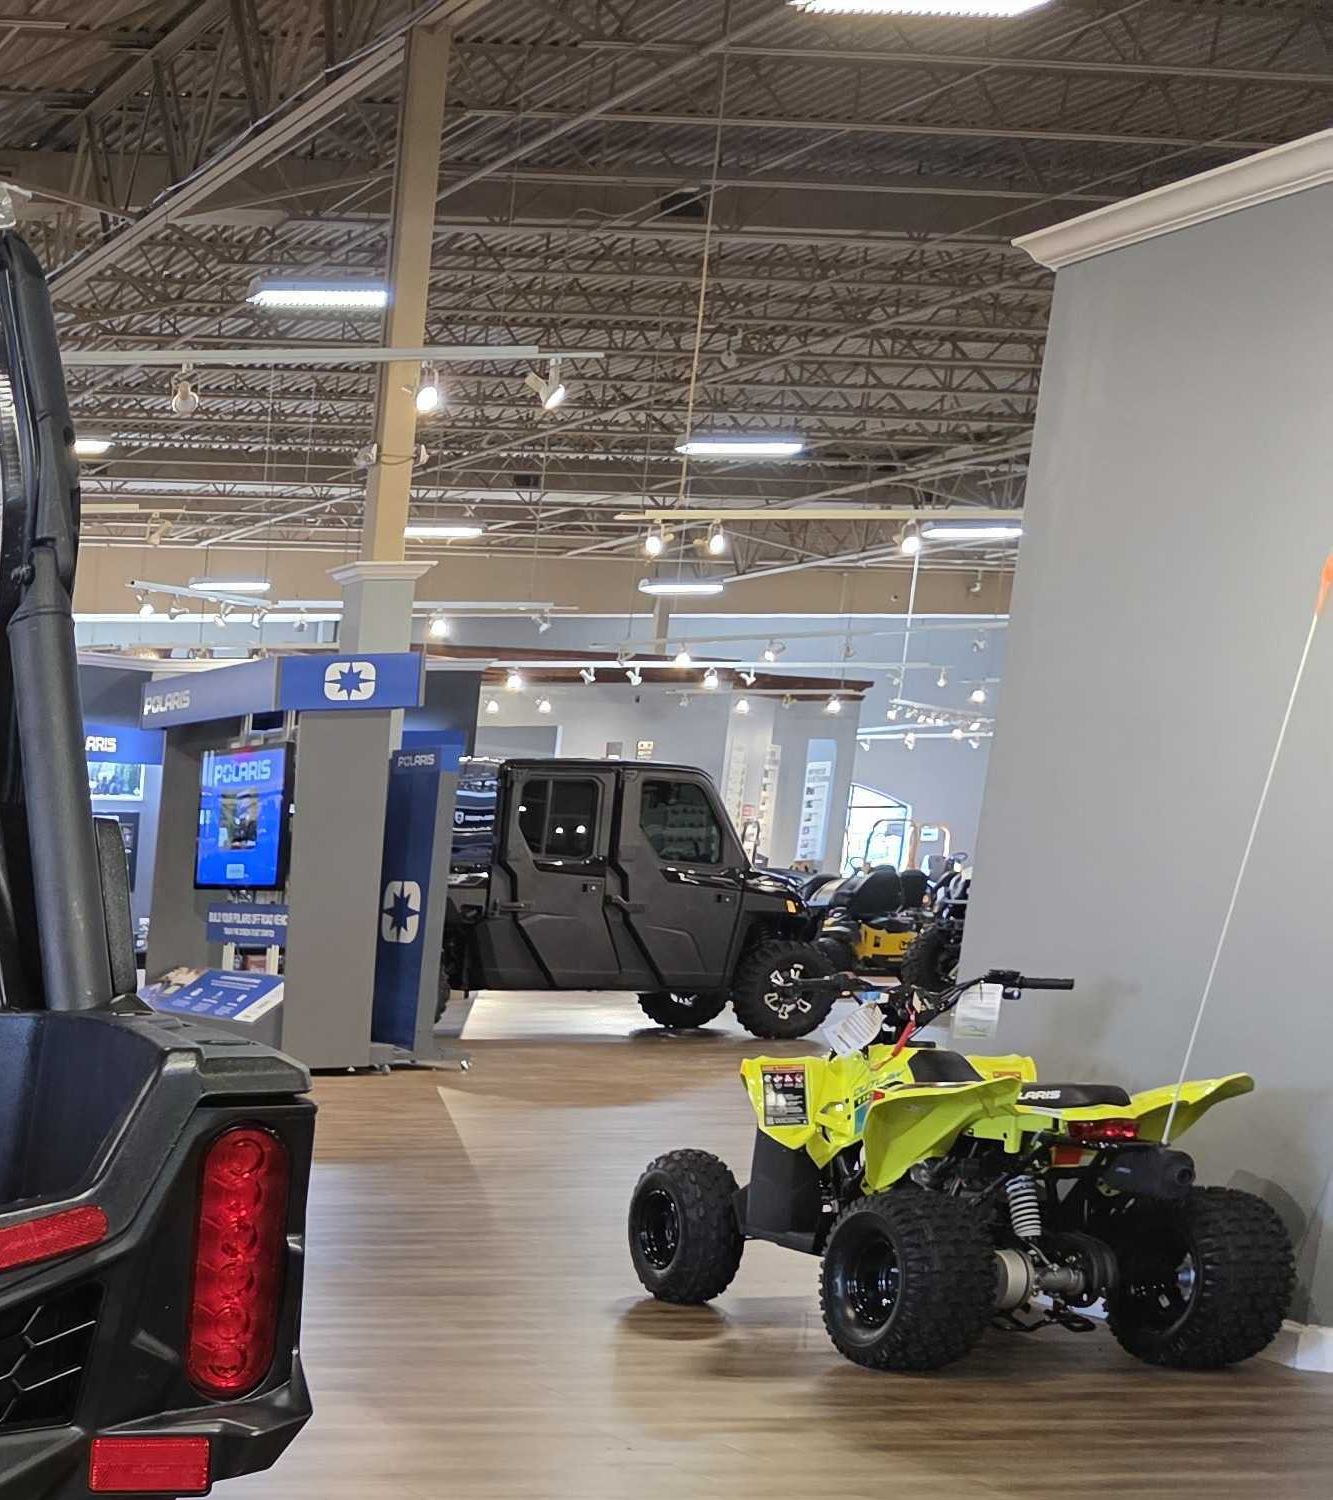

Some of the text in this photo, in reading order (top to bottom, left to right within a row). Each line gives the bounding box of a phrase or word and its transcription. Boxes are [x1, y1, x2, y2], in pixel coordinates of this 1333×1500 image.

[143, 689, 191, 716] POLARIS
[85, 735, 117, 753] ARIS
[398, 753, 435, 768] POLARIS
[214, 759, 271, 786] POLARIS
[1018, 1090, 1061, 1100] LARIS
